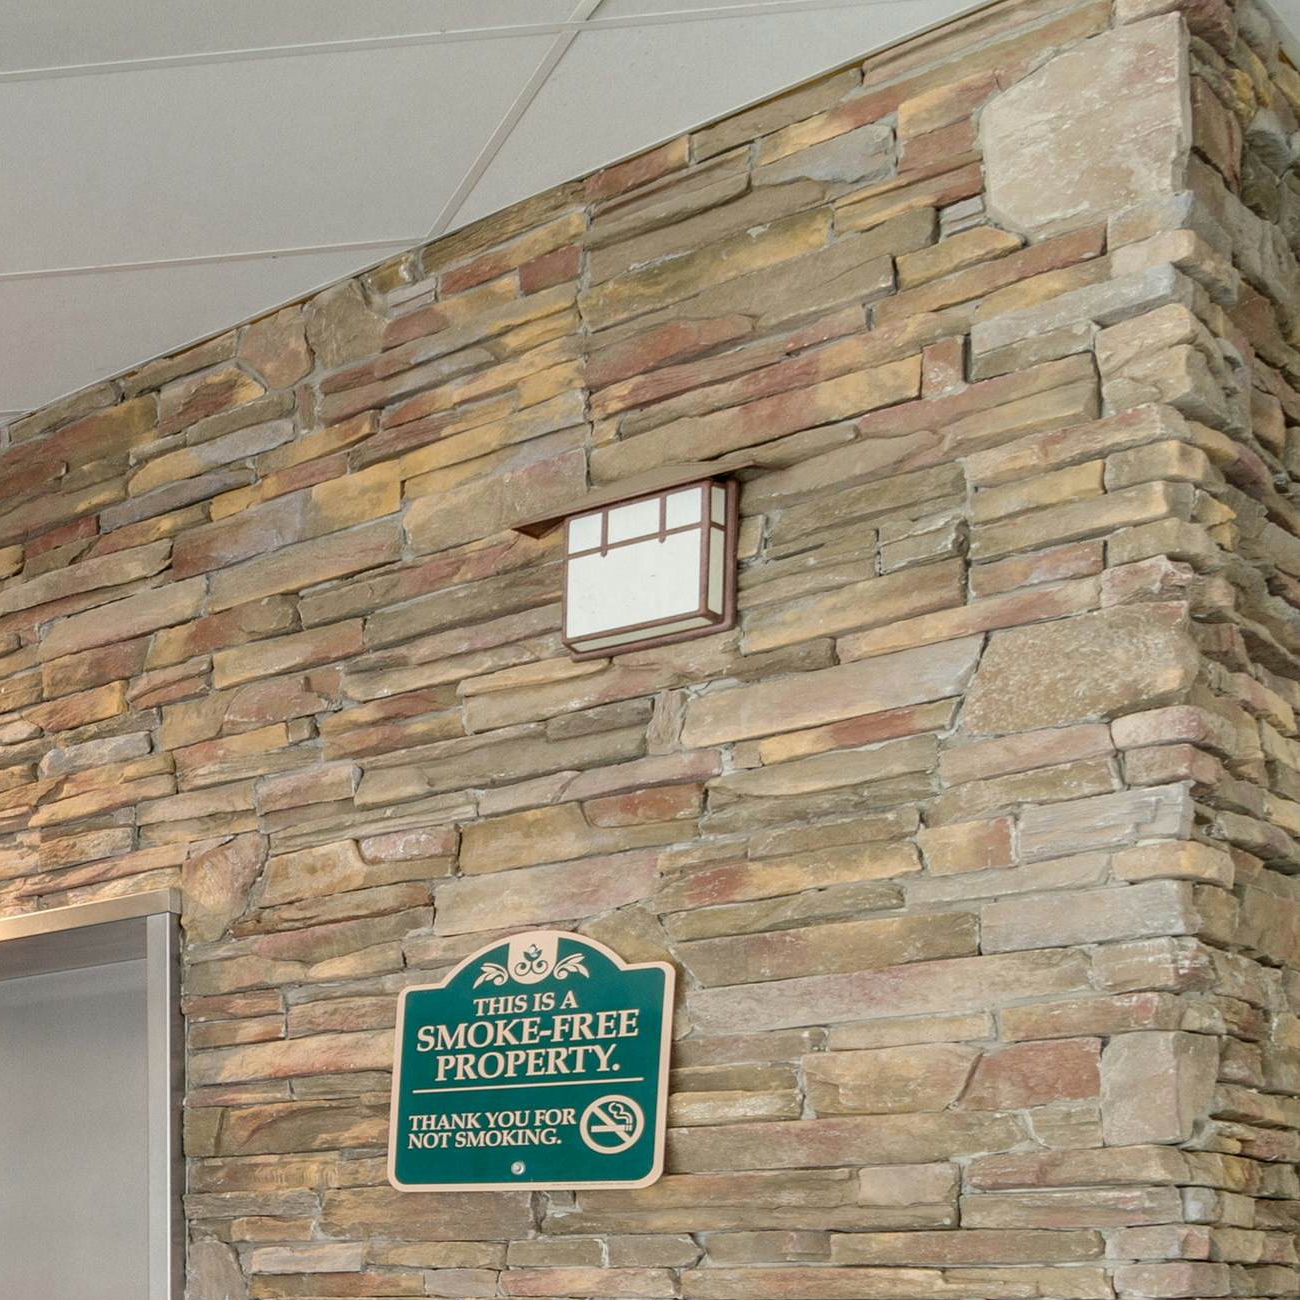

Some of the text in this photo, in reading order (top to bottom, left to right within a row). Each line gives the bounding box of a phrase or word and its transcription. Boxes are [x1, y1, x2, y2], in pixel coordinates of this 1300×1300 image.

[473, 990, 579, 1016] THIS IS A
[416, 1008, 639, 1052] SMOKE-FREE
[435, 1044, 621, 1082] PROPERTY.
[408, 1108, 576, 1131] THANK YOU FOR
[408, 1127, 562, 1150] NOT SMOKING.
